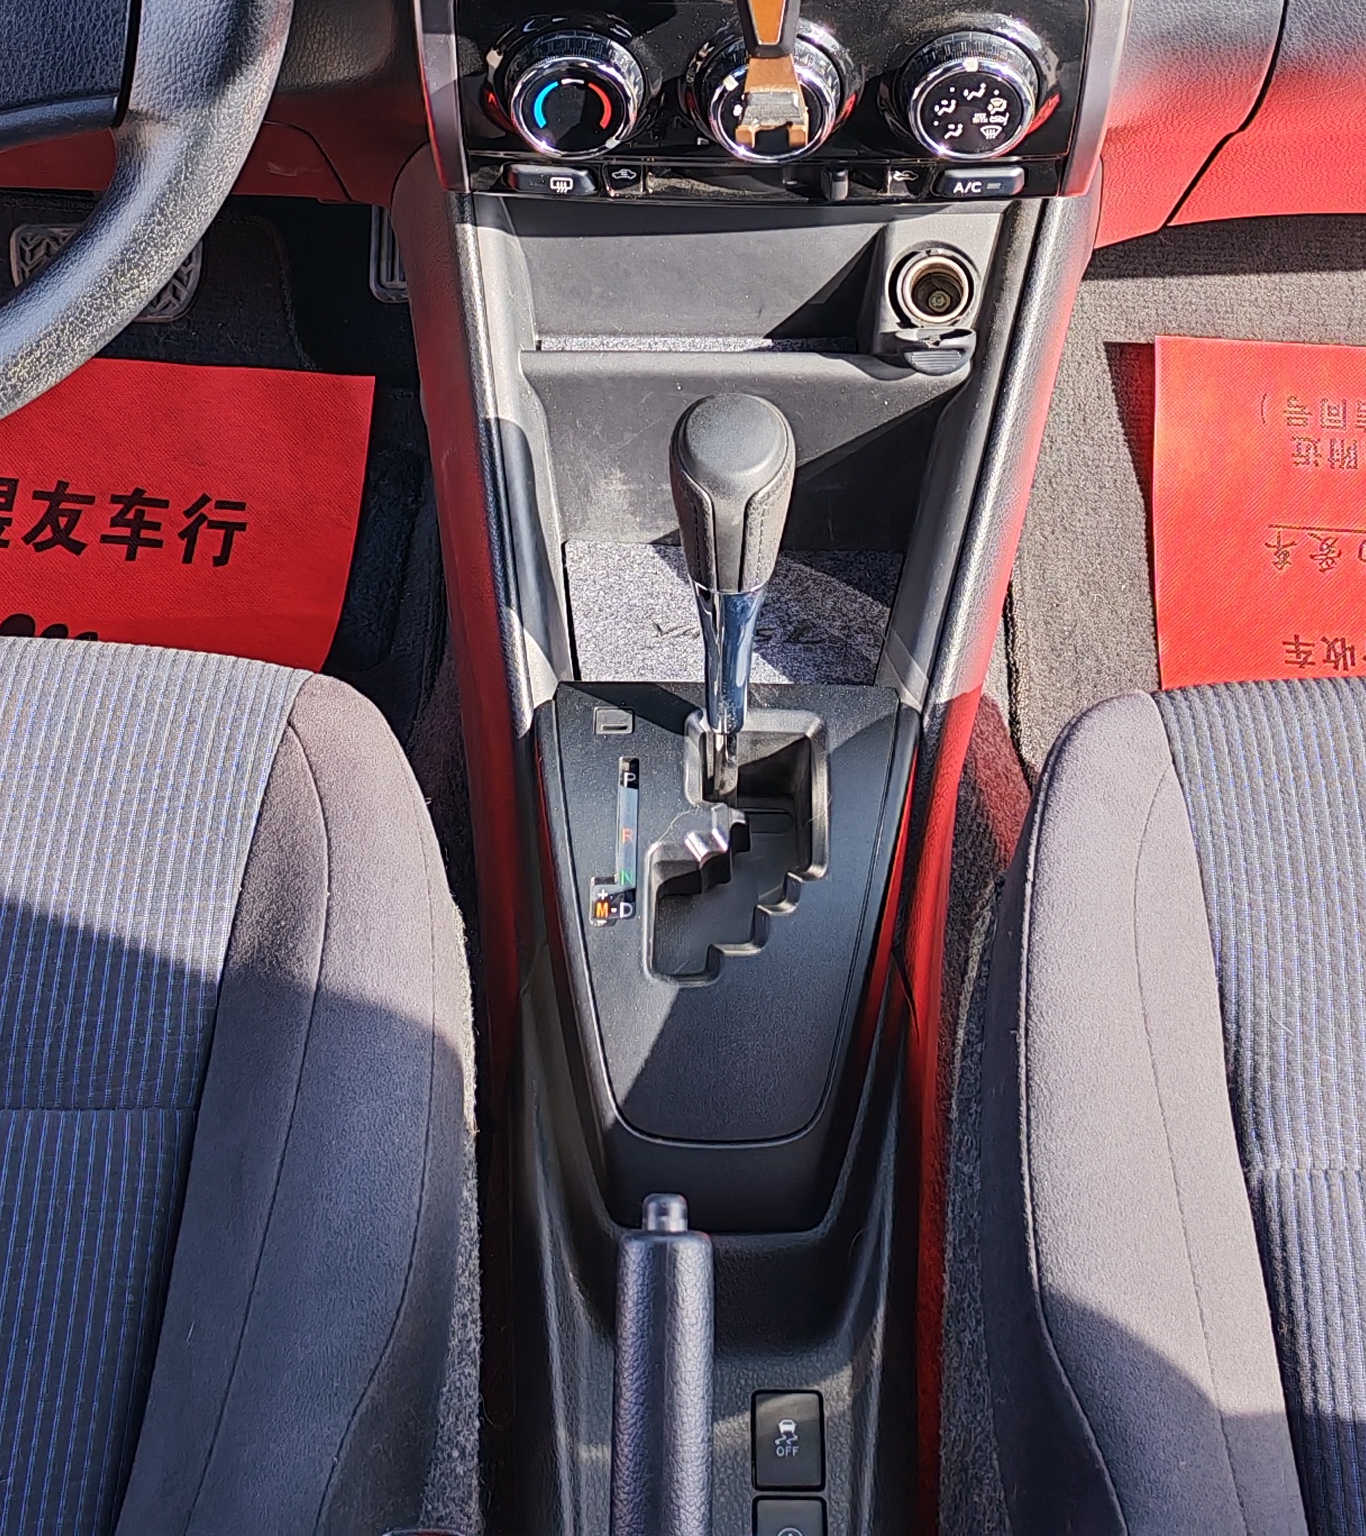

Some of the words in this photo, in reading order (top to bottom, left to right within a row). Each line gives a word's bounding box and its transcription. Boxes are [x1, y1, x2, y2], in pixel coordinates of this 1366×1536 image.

[953, 182, 982, 193] A/C
[624, 772, 636, 785] P
[622, 829, 633, 842] R
[621, 871, 633, 885] N
[596, 902, 608, 917] M
[620, 903, 633, 917] D
[776, 1446, 799, 1457] OFF
